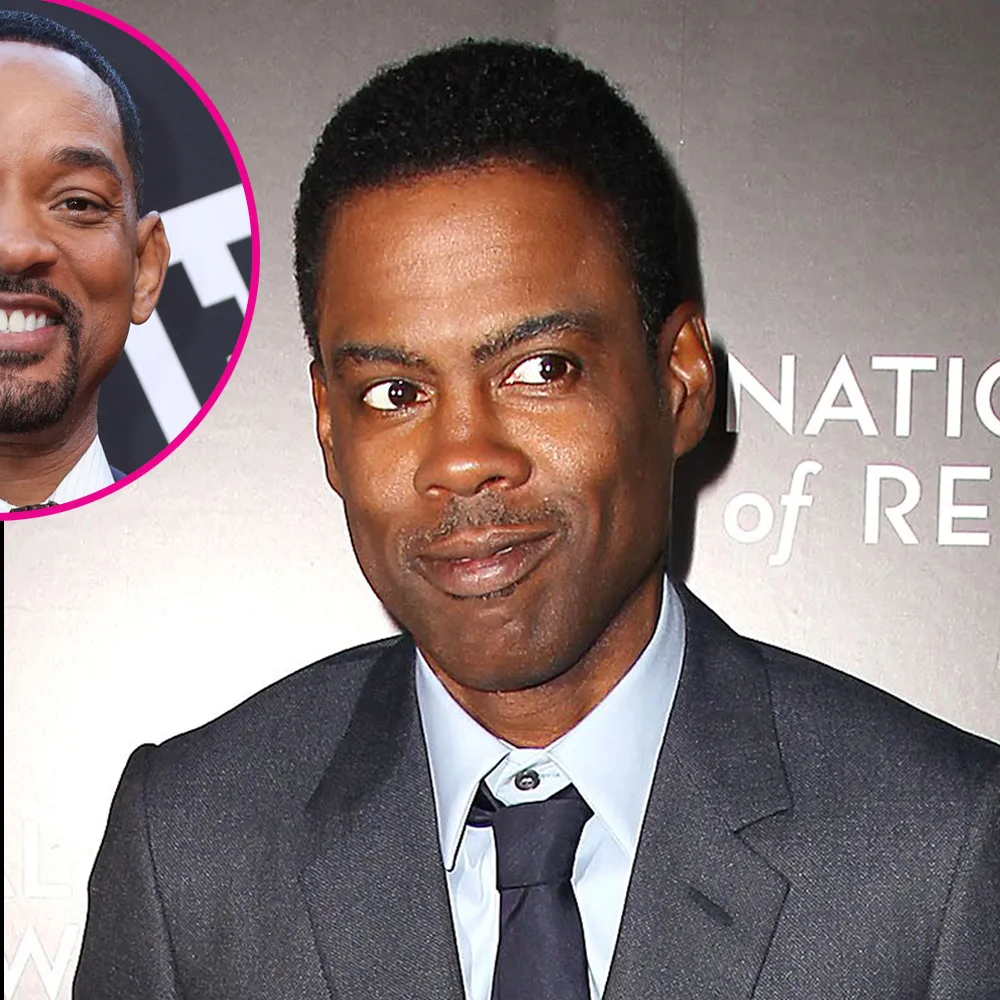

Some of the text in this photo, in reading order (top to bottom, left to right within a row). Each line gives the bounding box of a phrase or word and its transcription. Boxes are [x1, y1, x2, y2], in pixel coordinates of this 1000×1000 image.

[723, 460, 991, 567] of RE
[4, 819, 73, 899] L
